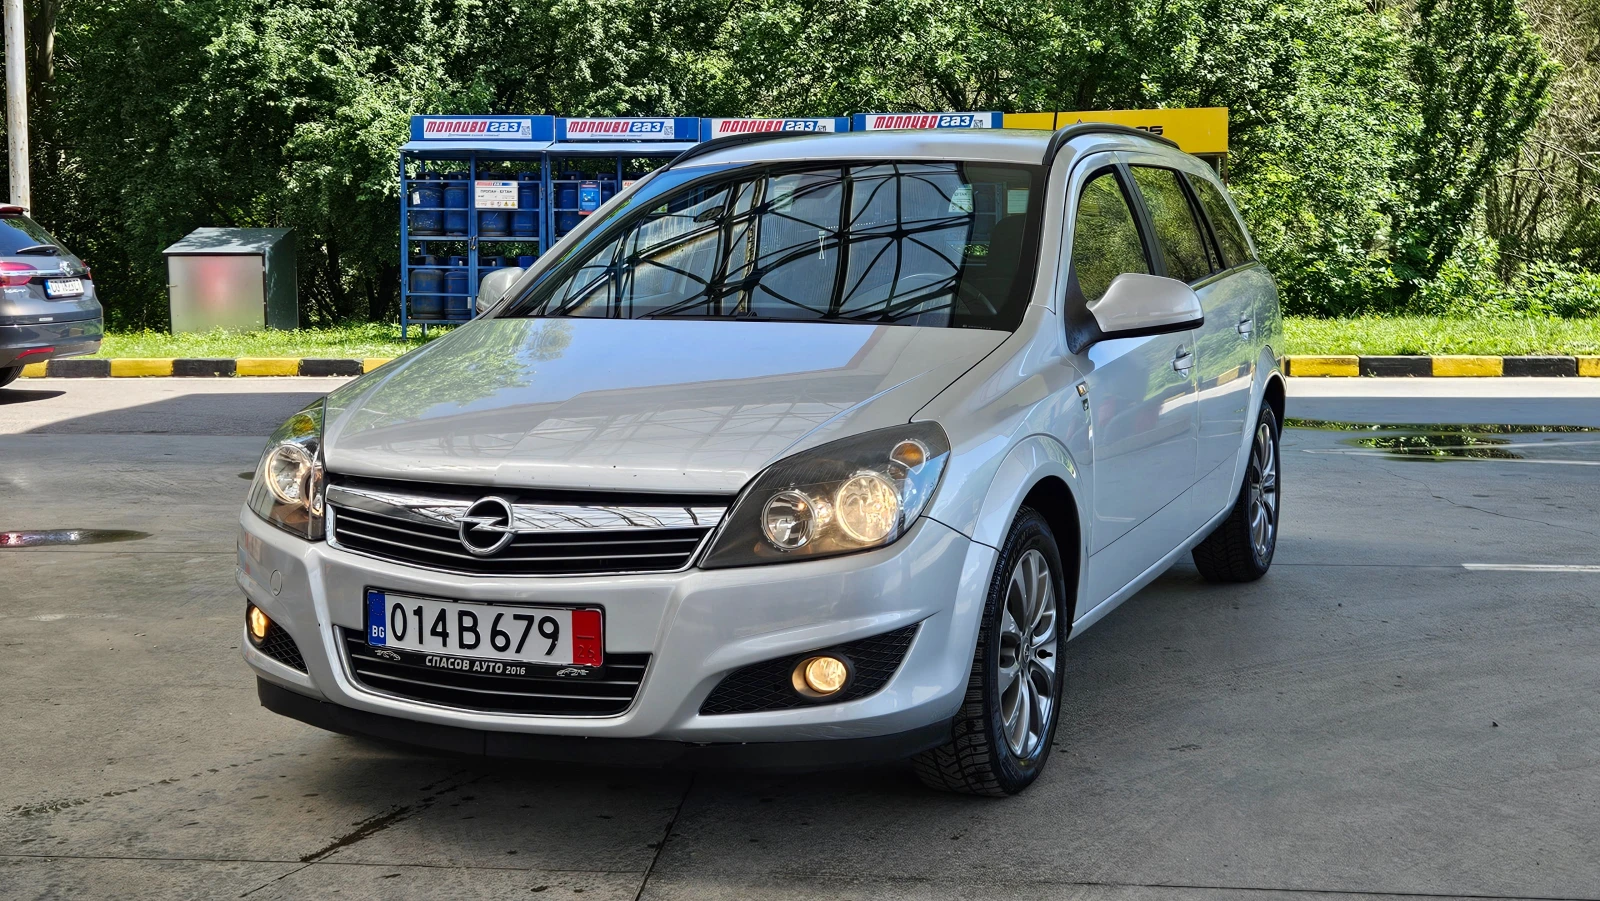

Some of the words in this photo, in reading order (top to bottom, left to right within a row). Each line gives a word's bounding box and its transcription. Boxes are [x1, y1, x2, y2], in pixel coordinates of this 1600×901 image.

[371, 625, 386, 638] BG
[425, 655, 470, 671] СПАСОВ
[472, 661, 503, 674] АУТО
[505, 665, 526, 675] 2016
